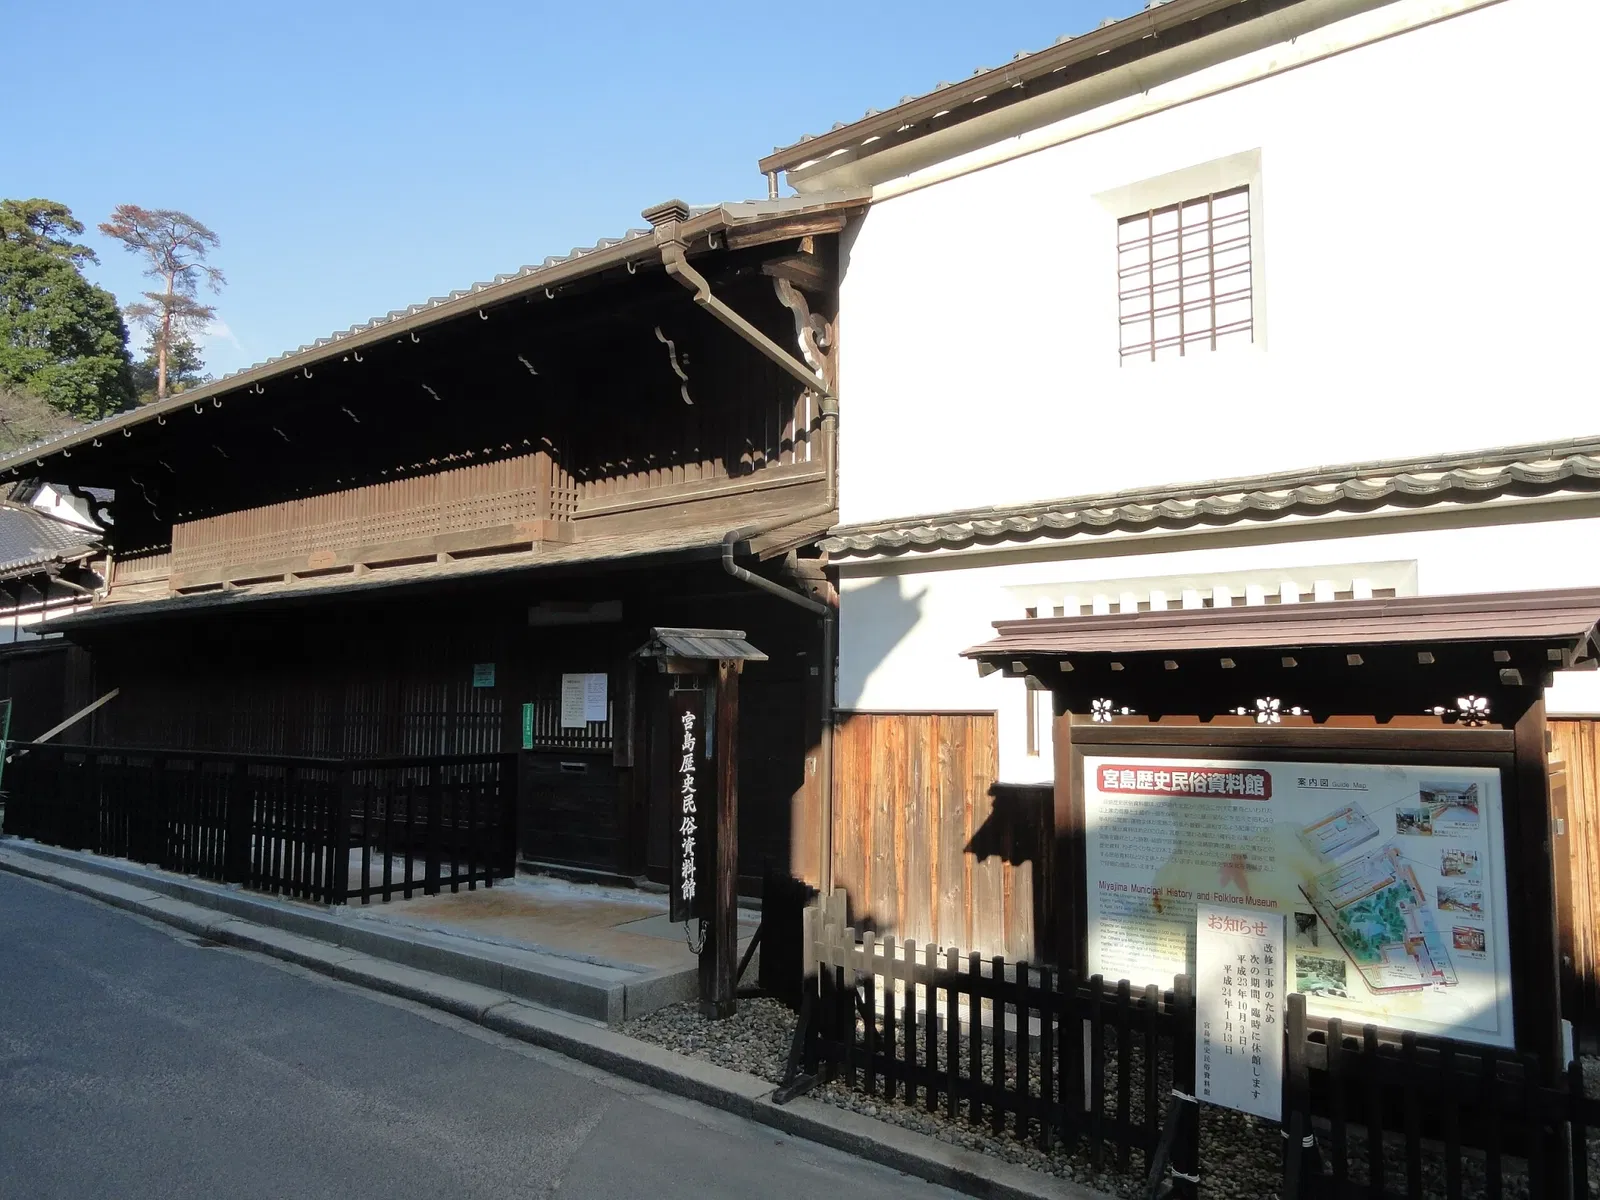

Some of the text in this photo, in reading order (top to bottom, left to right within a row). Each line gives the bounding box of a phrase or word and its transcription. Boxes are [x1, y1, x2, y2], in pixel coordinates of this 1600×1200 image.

[1102, 769, 1265, 795] 宮島歴史民俗資料館
[1298, 777, 1329, 787] 案内図
[1099, 880, 1128, 892] Miyajima
[1131, 883, 1163, 896] Municipal
[1166, 887, 1193, 901] History
[1197, 891, 1210, 901] and
[1213, 892, 1244, 905] Folklore
[1245, 895, 1278, 909] Museum
[1208, 914, 1268, 937] お知らせ
[1263, 943, 1275, 1024] 改修工事のため
[1221, 964, 1233, 1055] 平成24年1月13日
